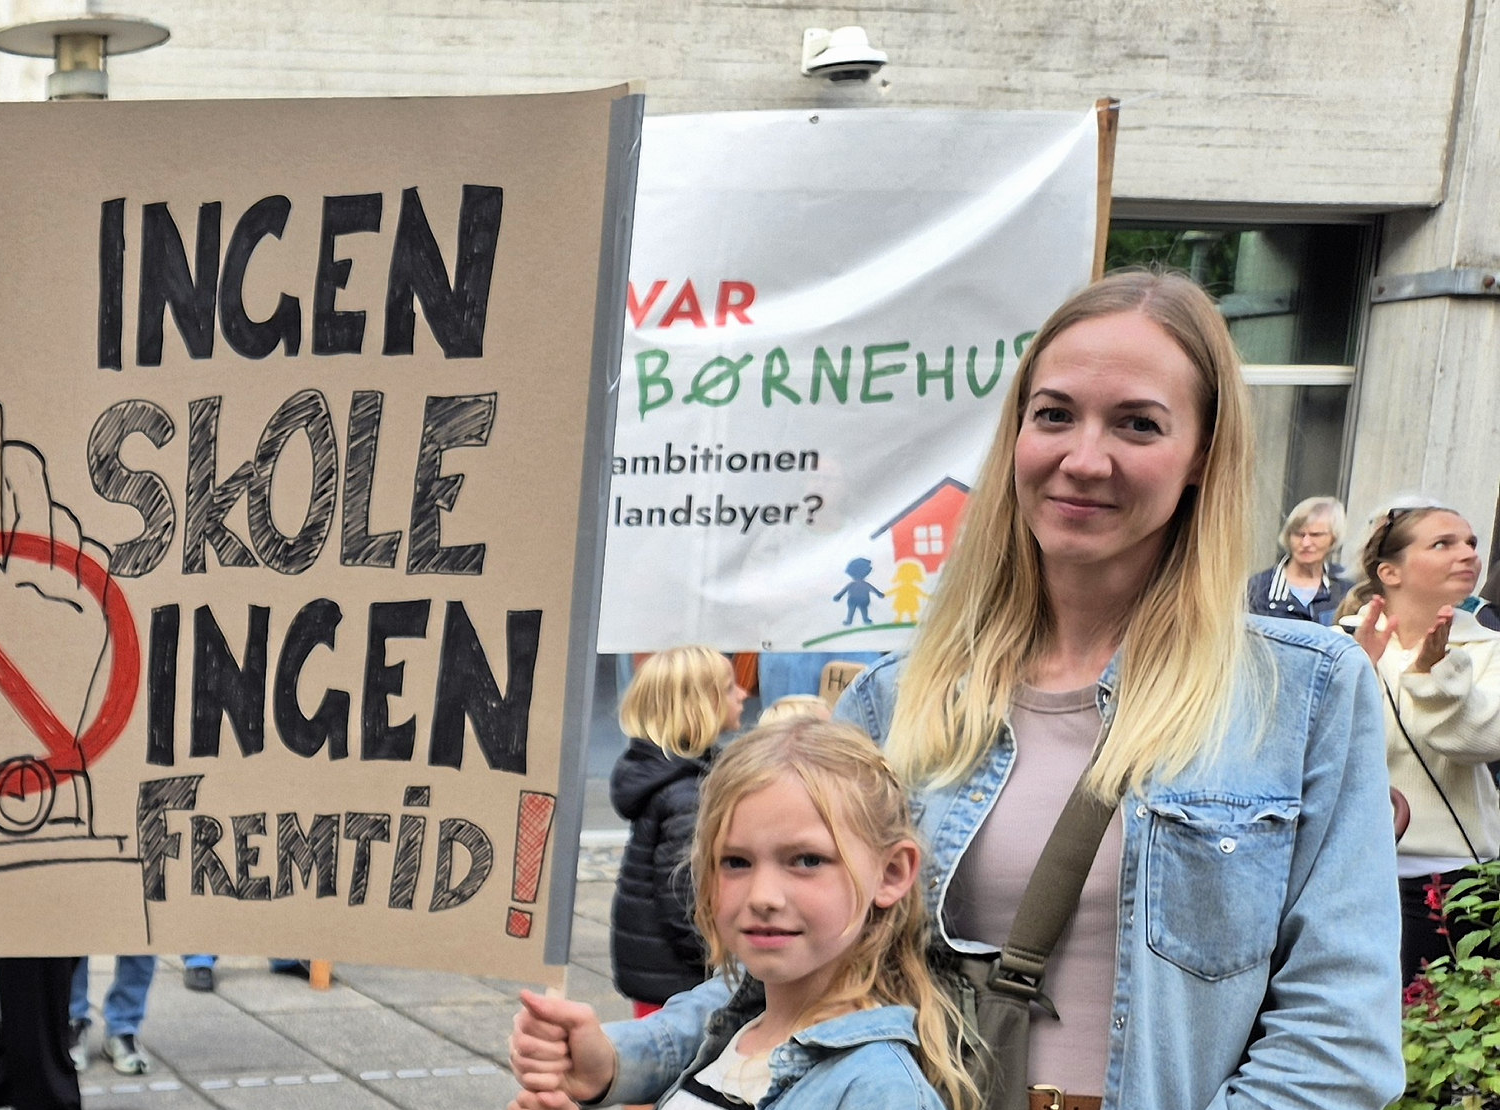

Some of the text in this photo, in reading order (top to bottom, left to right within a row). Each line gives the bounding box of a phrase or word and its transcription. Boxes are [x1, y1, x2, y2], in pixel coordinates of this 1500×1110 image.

[97, 184, 504, 370] INGEN
[612, 442, 819, 475] ambitionen
[614, 493, 823, 534] landsbyer?
[146, 598, 543, 774] INGEN
